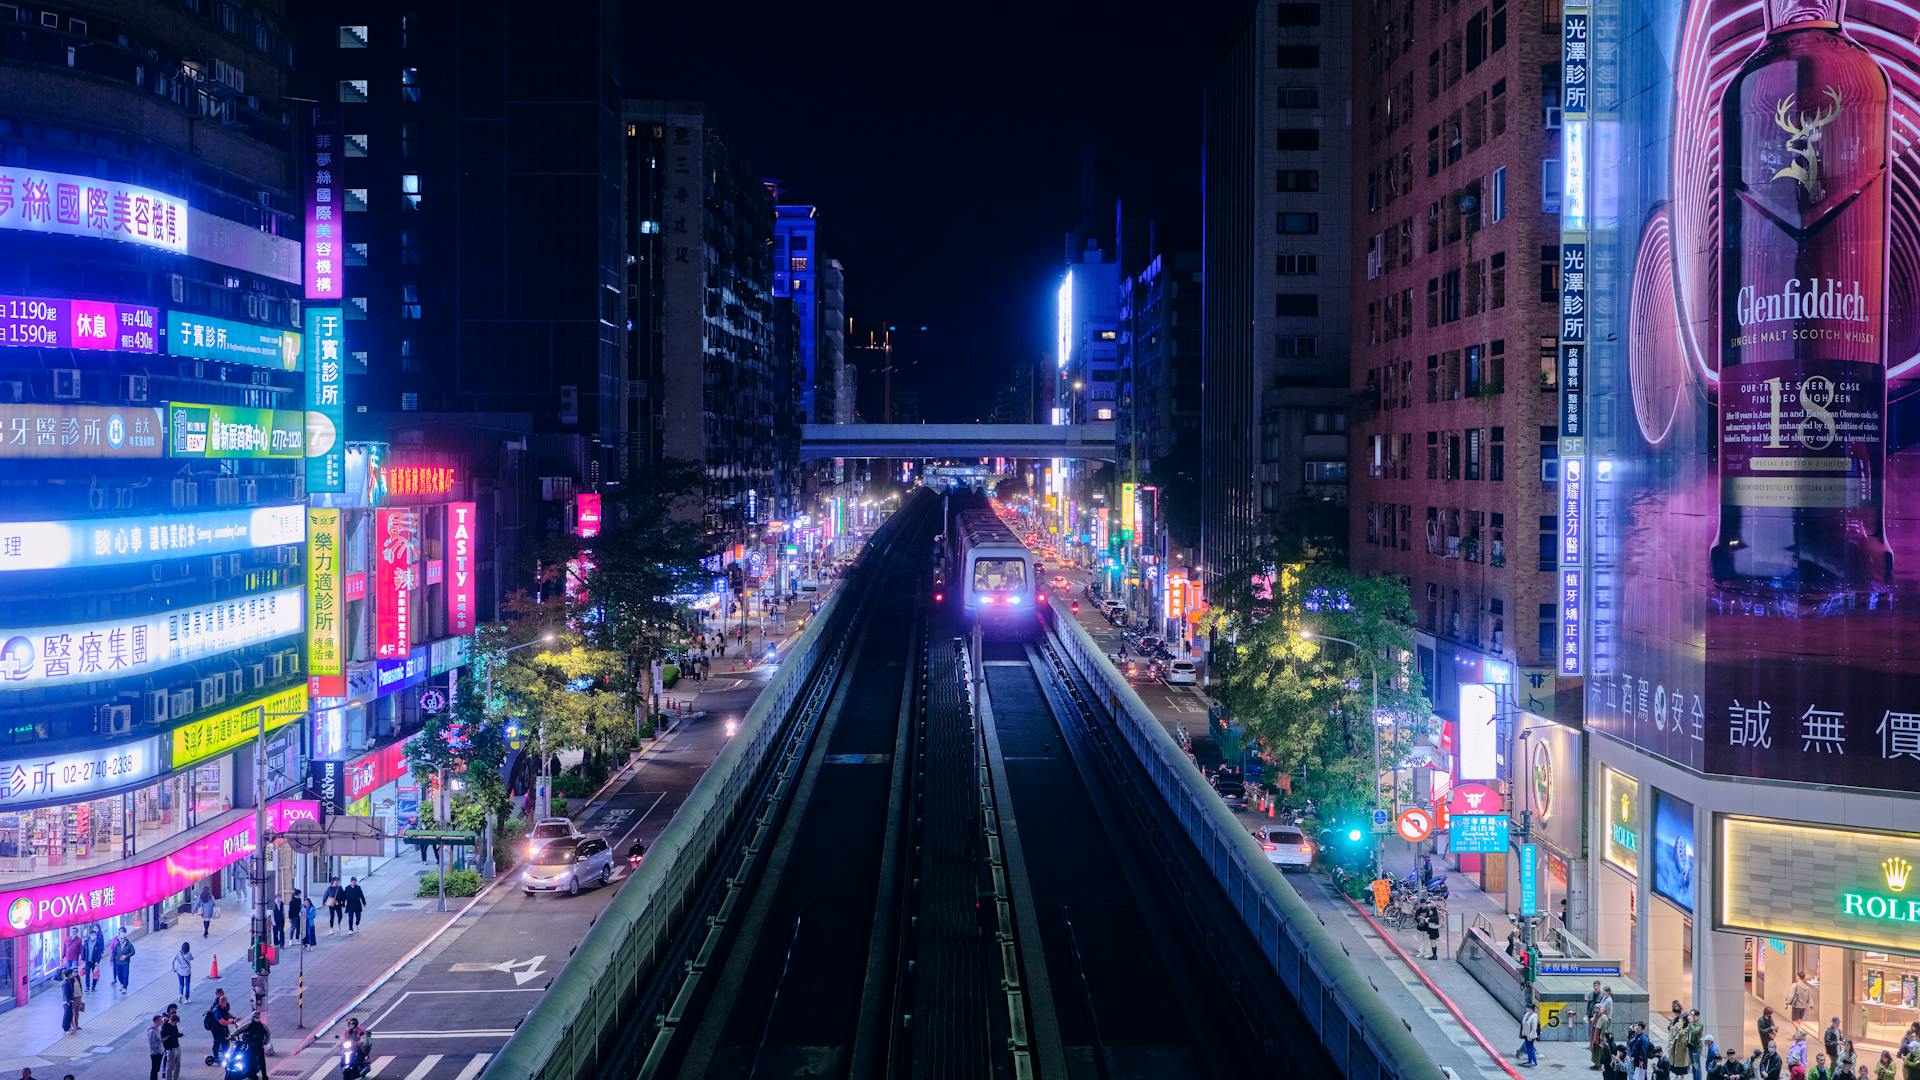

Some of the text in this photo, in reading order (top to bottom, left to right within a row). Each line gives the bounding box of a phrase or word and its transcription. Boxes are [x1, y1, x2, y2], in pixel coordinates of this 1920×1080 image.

[1566, 19, 1586, 107] 光澤診所
[315, 134, 332, 292] 菲夢絲國際美容機構
[1564, 250, 1584, 338] 光澤診所
[1737, 277, 1868, 327] Glenfiddich
[77, 312, 107, 338] 休息
[181, 322, 227, 350] 于賓診所
[1731, 329, 1875, 348] SINGLE MALT SCOTCH WHISKY
[322, 316, 338, 405] 于賓診所
[1752, 393, 1851, 404] FINIED EIGHEEN
[1760, 382, 1791, 392] TRLE
[1839, 382, 1860, 392] CASK
[1757, 421, 1772, 430] furth
[1814, 420, 1823, 432] by
[1759, 410, 1788, 419] Amean
[1790, 409, 1805, 418] and
[1762, 375, 1836, 451] 18
[0, 417, 102, 446] 牙醫診所
[272, 429, 302, 450] 2772-1120
[1564, 438, 1581, 452] 5F
[4, 535, 22, 557] 理
[95, 527, 142, 556] 談心事
[454, 508, 468, 587] TASTY
[314, 532, 333, 631] 樂力適診所
[43, 624, 148, 678] 醫療集團
[313, 637, 333, 648] 疼痛
[313, 649, 333, 660] 治療
[380, 644, 395, 655] 4F
[378, 664, 405, 688] Panasonic
[1591, 666, 1704, 742] 禁止酒駕 安全
[1728, 698, 1920, 760] 誠無價
[0, 761, 56, 799] 診所
[63, 754, 133, 784] 02-2740-2338
[325, 762, 335, 800] BRAND
[283, 809, 314, 820] POYA
[224, 837, 239, 857] POYA
[1613, 823, 1638, 852] ROLEX
[38, 885, 116, 921] POYA 寶雅
[1844, 893, 1920, 922] ROLE
[1547, 1009, 1560, 1028] 5
